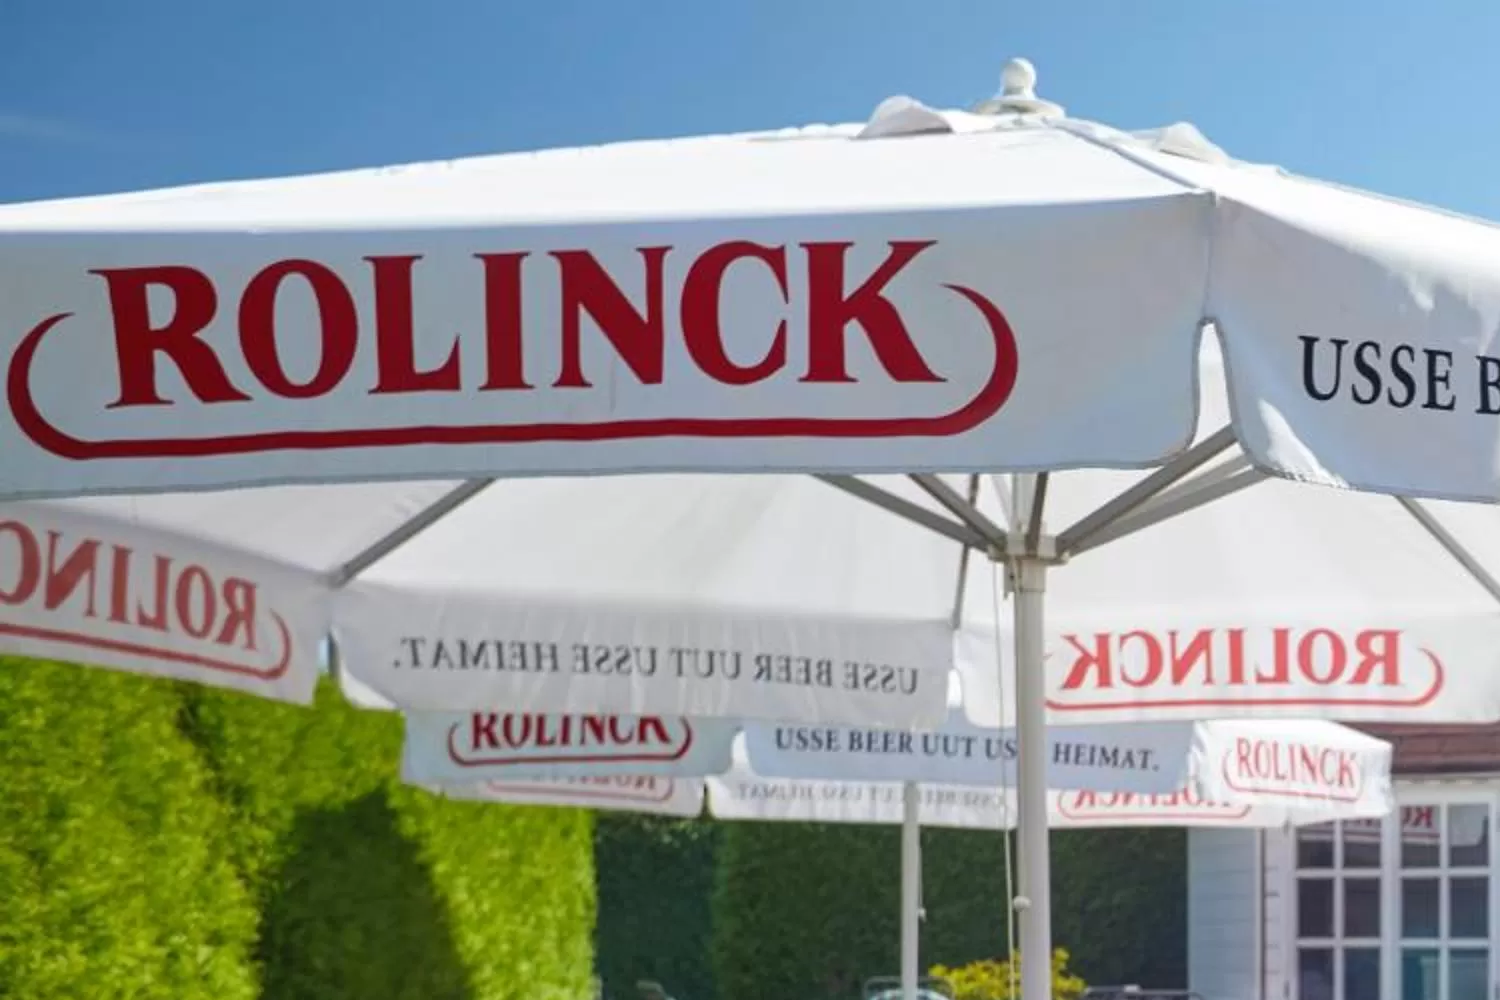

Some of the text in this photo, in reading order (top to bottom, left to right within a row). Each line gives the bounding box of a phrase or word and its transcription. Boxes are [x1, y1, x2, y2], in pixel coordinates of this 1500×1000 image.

[88, 239, 948, 409] ROLINCK
[1298, 335, 1457, 413] USSE
[775, 727, 1160, 773] USSE BEER UUT US HEIMAT.
[1236, 737, 1360, 788] ROLINCK
